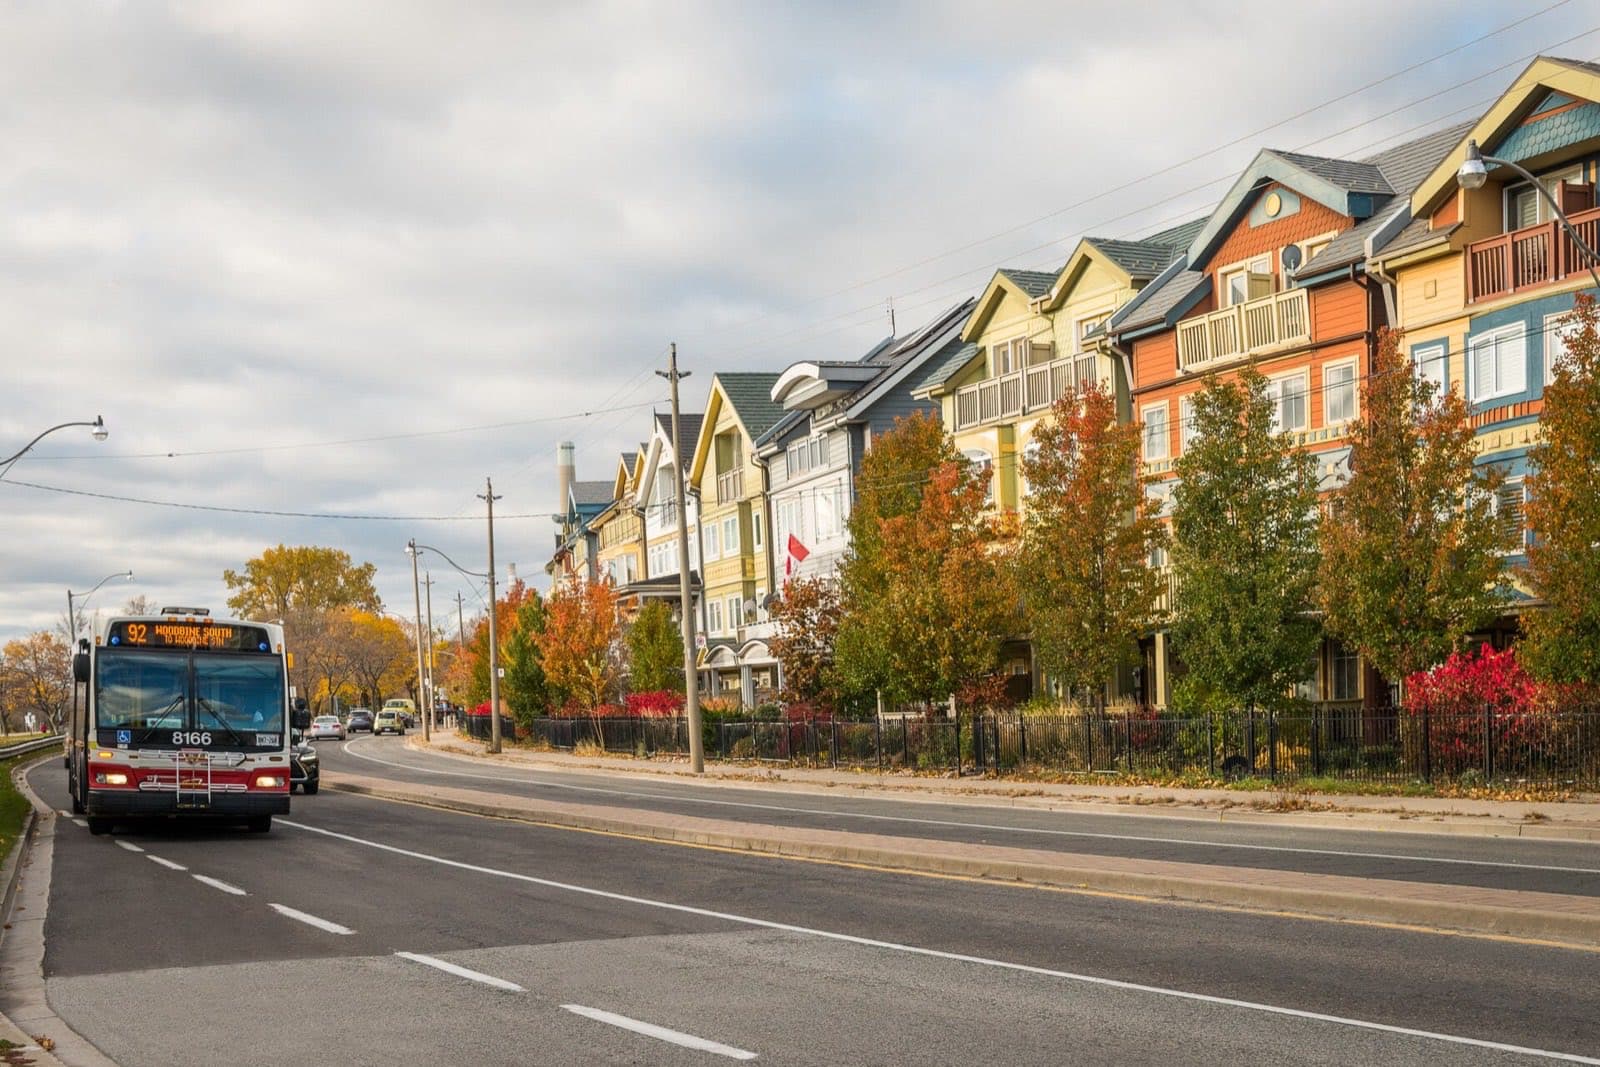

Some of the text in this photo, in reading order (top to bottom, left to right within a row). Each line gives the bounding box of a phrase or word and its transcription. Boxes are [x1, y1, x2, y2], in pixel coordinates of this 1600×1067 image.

[127, 624, 147, 643] 92
[155, 625, 233, 639] WOODBINE SOUTH
[172, 731, 212, 745] 8166
